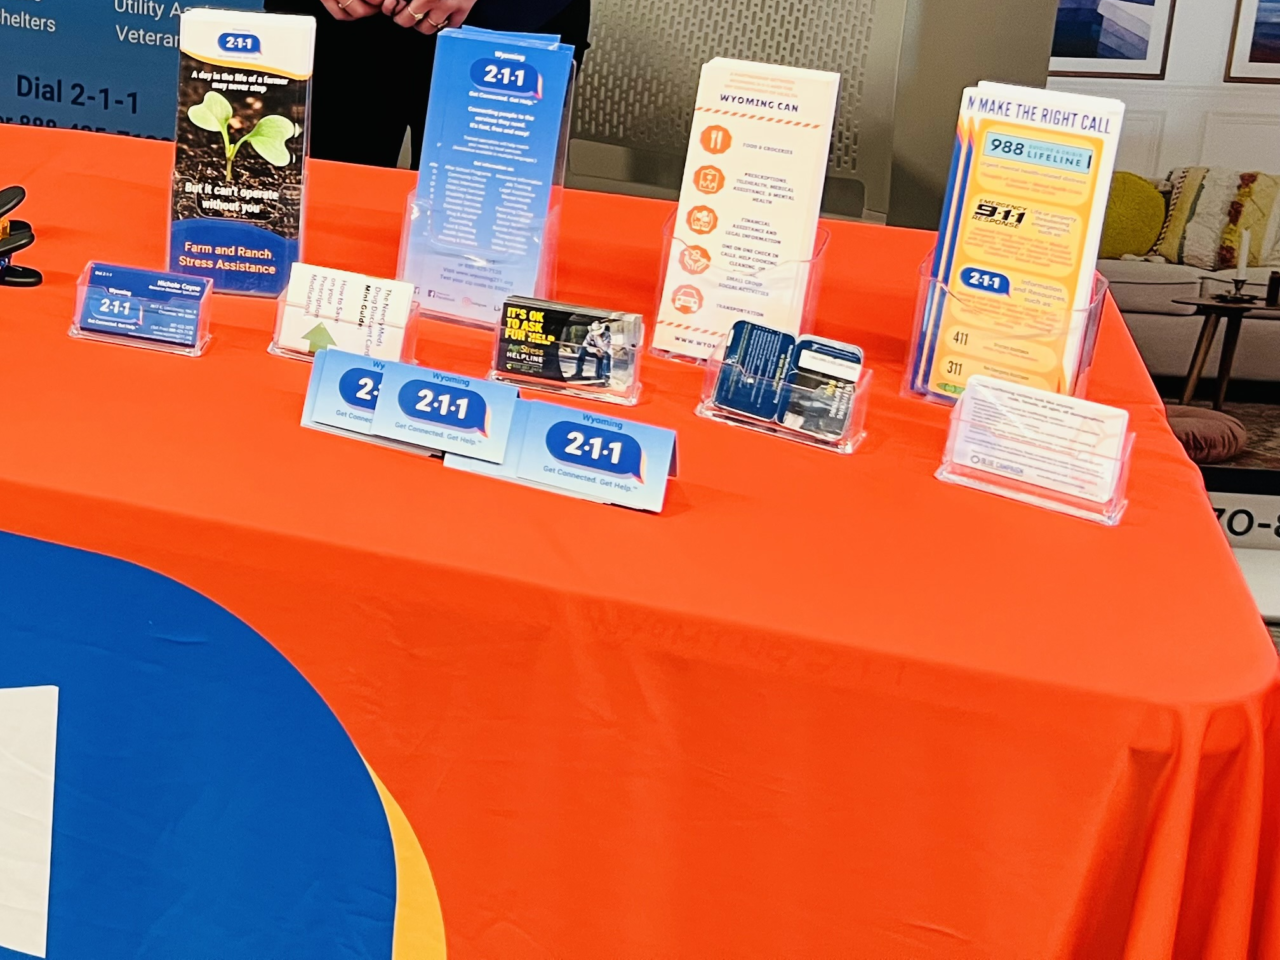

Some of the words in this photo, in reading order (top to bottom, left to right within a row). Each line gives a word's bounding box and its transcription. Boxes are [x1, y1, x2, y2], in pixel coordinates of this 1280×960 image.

[191, 70, 197, 78] A
[199, 71, 212, 81] day
[222, 71, 233, 81] the
[235, 73, 247, 82] life
[248, 74, 257, 83] of
[264, 76, 289, 85] farmer
[16, 75, 62, 104] Dial
[70, 82, 138, 114] 2-1-1
[720, 94, 774, 109] WYOMING
[777, 102, 798, 112] CAN
[978, 97, 1012, 117] MAKE
[1015, 104, 1038, 121] THE
[1040, 108, 1079, 128] RIGHT
[1080, 114, 1111, 134] CALL
[991, 138, 1025, 156] 988
[1027, 150, 1081, 167] LIFELINE
[185, 182, 203, 193] But
[204, 183, 212, 194] it
[214, 185, 238, 196] can't
[240, 189, 279, 200] operate
[202, 199, 240, 210] without
[241, 203, 260, 214] you
[979, 199, 1028, 211] EMERGENCY
[971, 215, 1020, 229] RESPONSE
[185, 242, 212, 253] Farm
[215, 246, 235, 255] and
[238, 247, 272, 259] Ranch
[179, 256, 213, 268] Stress
[216, 259, 276, 274] Assistance
[331, 278, 336, 287] on
[339, 280, 347, 297] How
[327, 287, 335, 305] your
[337, 297, 343, 305] to
[371, 286, 381, 307] Drug
[383, 289, 392, 303] The
[507, 307, 527, 319] IT'S
[529, 310, 544, 322] OK
[506, 318, 519, 329] TO
[521, 320, 543, 333] ASK
[953, 331, 968, 346] 411
[947, 360, 962, 376] 311
[432, 372, 470, 388] Wyoming
[336, 409, 347, 418] Get
[582, 413, 623, 430] Wyoming
[395, 421, 407, 430] Get
[408, 425, 445, 438] Connected.
[446, 434, 459, 442] Get
[543, 465, 556, 474] Get
[557, 468, 597, 483] Connected.
[600, 478, 613, 487] Get
